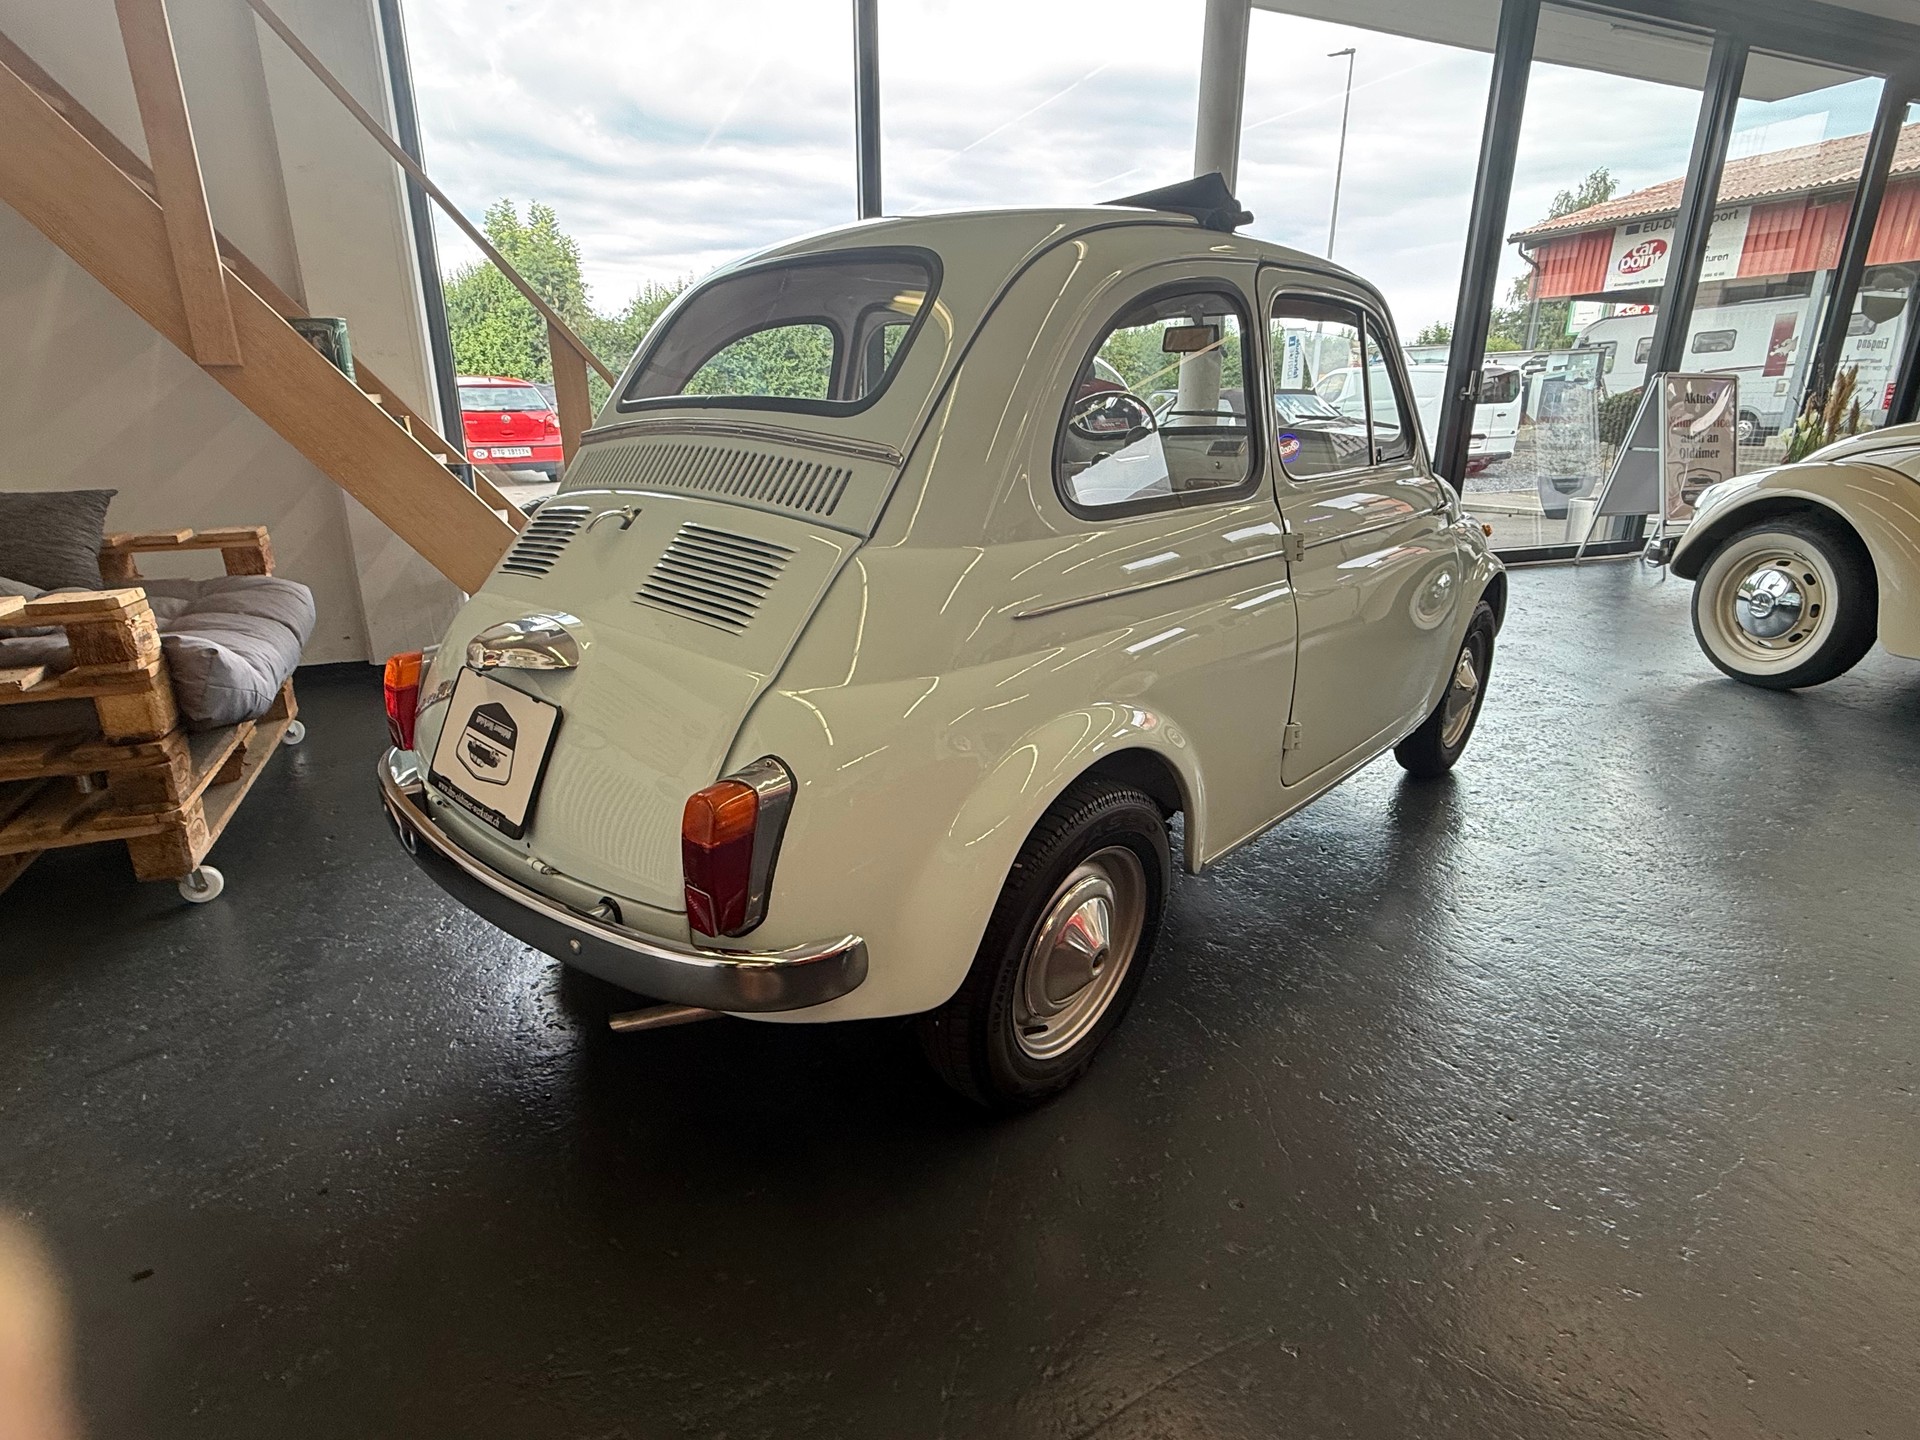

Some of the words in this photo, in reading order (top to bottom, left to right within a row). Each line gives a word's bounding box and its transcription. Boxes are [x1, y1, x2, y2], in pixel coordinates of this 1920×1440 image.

[1632, 242, 1658, 257] car
[1619, 250, 1662, 271] point
[1706, 433, 1719, 443] an
[1679, 446, 1720, 459] Oldtimer
